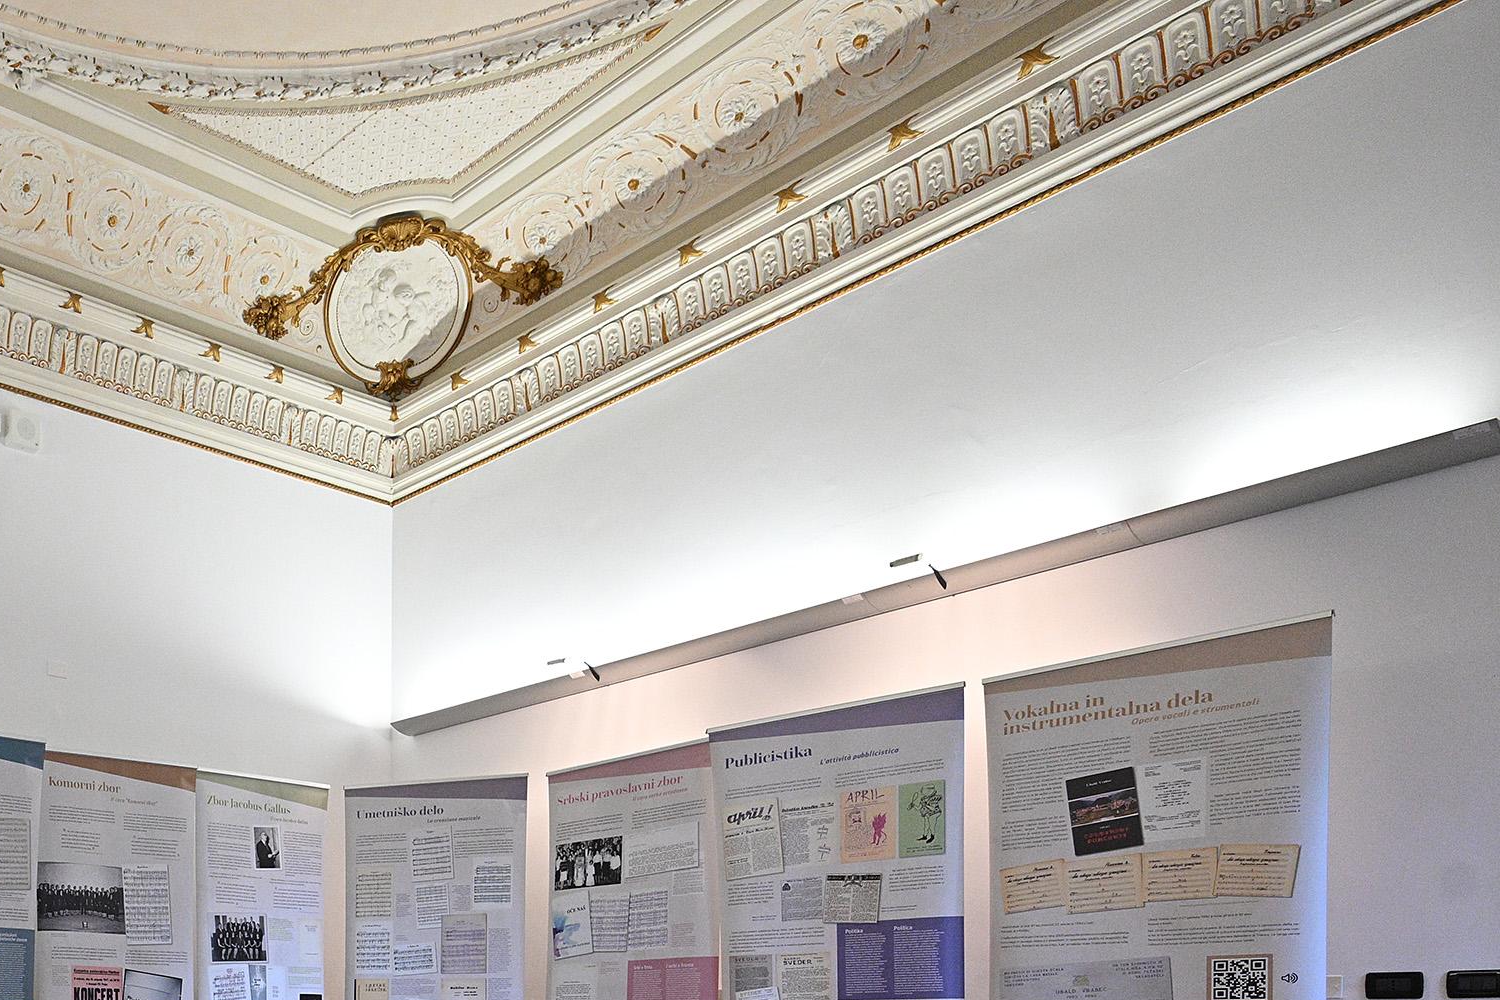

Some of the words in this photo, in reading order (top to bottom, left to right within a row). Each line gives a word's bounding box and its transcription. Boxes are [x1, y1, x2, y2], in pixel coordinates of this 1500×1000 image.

[1003, 700, 1079, 721] Vokalna
[1085, 695, 1105, 708] in
[1003, 701, 1161, 736] instrumentalna
[1167, 689, 1214, 710] dela
[1162, 709, 1190, 721] vocali
[1200, 698, 1260, 715] strumentali
[725, 746, 812, 769] Publicistika
[852, 747, 900, 761] pubblicistica
[49, 776, 95, 791] Komorni
[98, 781, 121, 793] zbor
[591, 779, 654, 802] pravoslavni
[657, 776, 683, 786] zbor
[231, 798, 263, 811] Jacobus
[264, 803, 291, 814] Gallus
[846, 789, 885, 803] APRIL
[357, 807, 417, 819] Umetniško
[419, 805, 444, 816] delo
